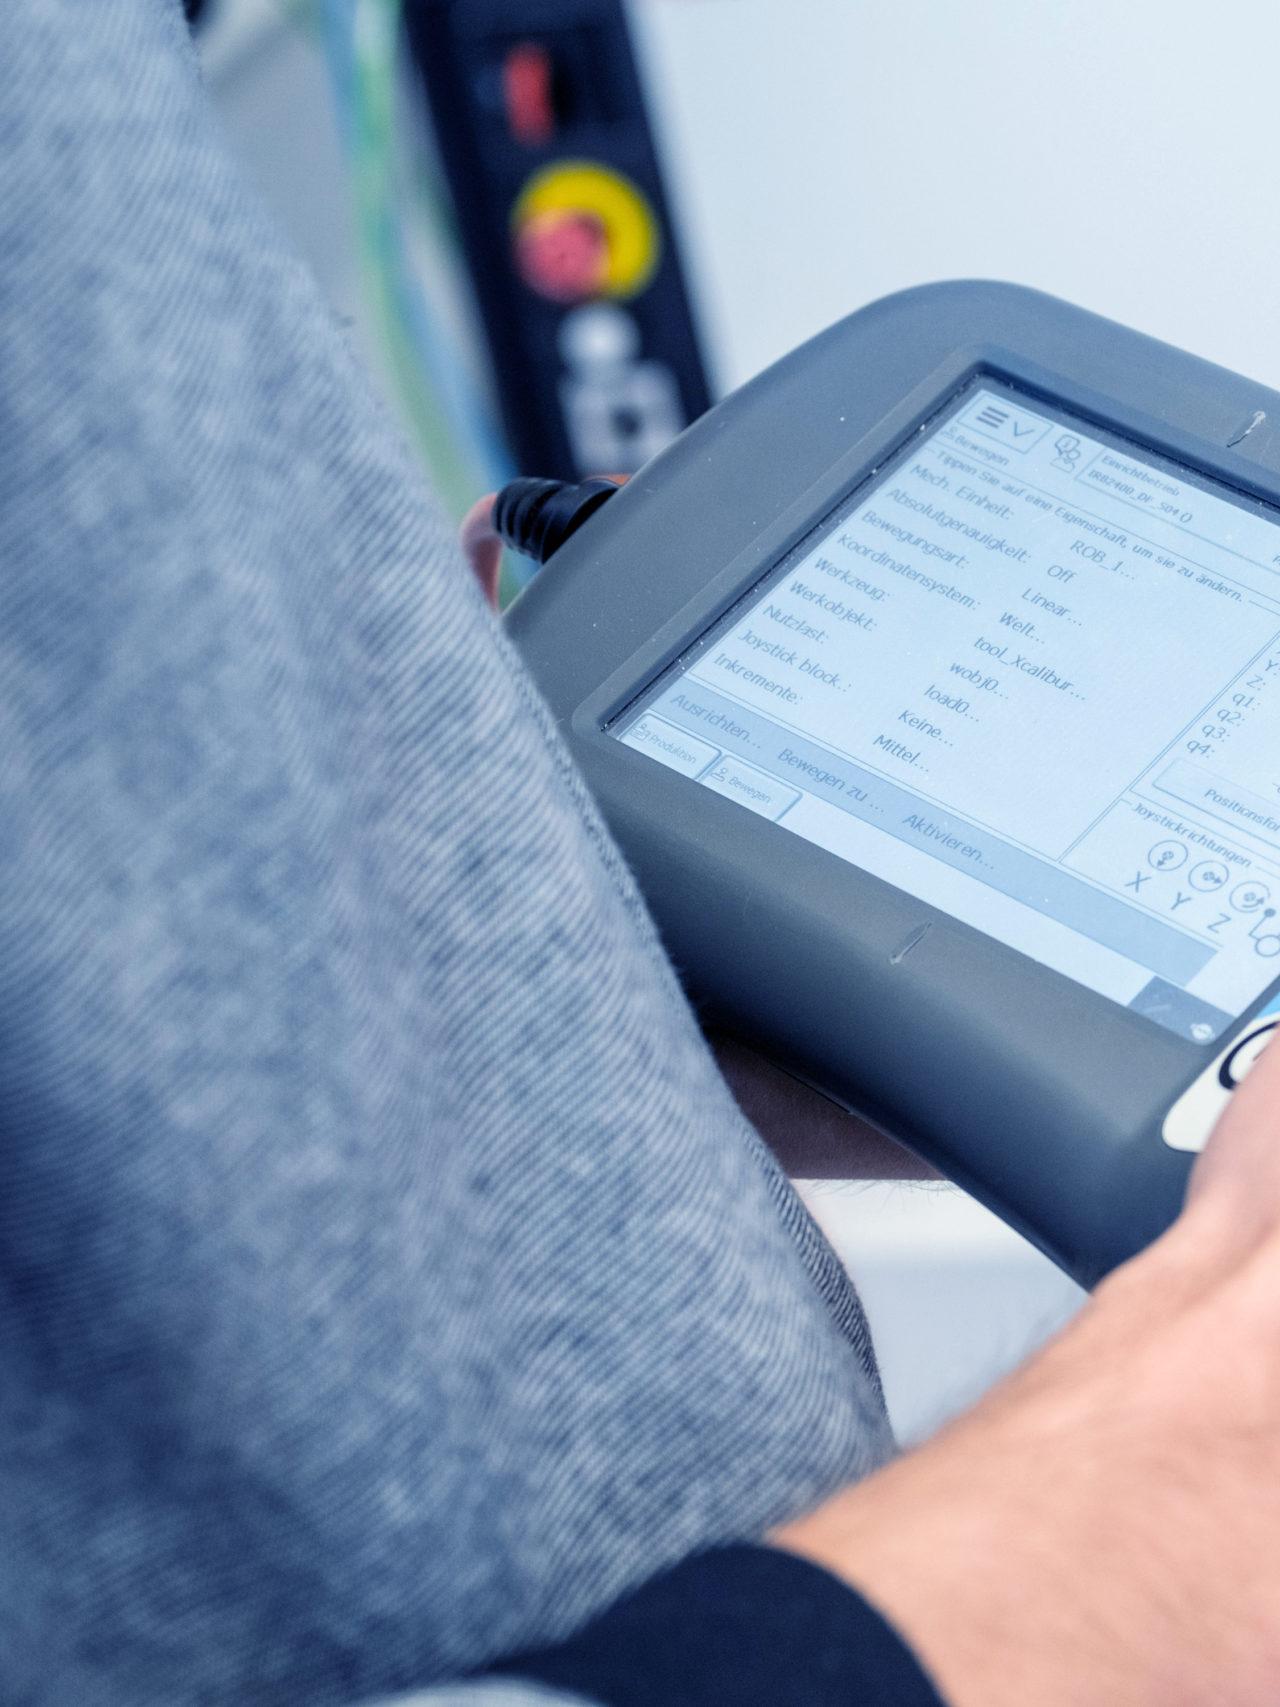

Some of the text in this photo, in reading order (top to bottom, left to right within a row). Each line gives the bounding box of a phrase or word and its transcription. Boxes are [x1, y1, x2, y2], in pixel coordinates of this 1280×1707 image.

[952, 434, 1010, 467] Bewegen
[908, 463, 1014, 521] Mech. Einheit:
[860, 509, 970, 569] Bewegungsart:
[884, 487, 1032, 564] Absolutgenauigkeit:
[936, 449, 978, 476] Tippen
[977, 470, 1001, 487] Sie
[1000, 483, 1027, 497] auf
[1023, 493, 1054, 512] eine
[1131, 543, 1154, 559] um
[1154, 555, 1176, 569] sie
[1176, 565, 1195, 579] zu
[1194, 572, 1242, 603] ändern.
[813, 556, 891, 602] Werkzeug:
[835, 532, 981, 609] Koordinatensystem:
[1046, 564, 1077, 584] Off
[761, 603, 829, 642] Nutzlast:
[788, 579, 878, 632] Werkobjekt:
[736, 627, 798, 666] Joystick
[711, 651, 798, 705] Inkremente:
[1245, 673, 1267, 692] Z:
[1215, 707, 1246, 727] q2:
[1231, 692, 1261, 711] q1:
[1185, 739, 1216, 759] q4:
[1200, 723, 1231, 743] q3:
[727, 775, 772, 804] Bewegen
[776, 747, 847, 791] Bewegen
[845, 784, 869, 803] zu
[1130, 801, 1252, 868] Joystickrichtungen
[1123, 869, 1233, 934] X Y Z
